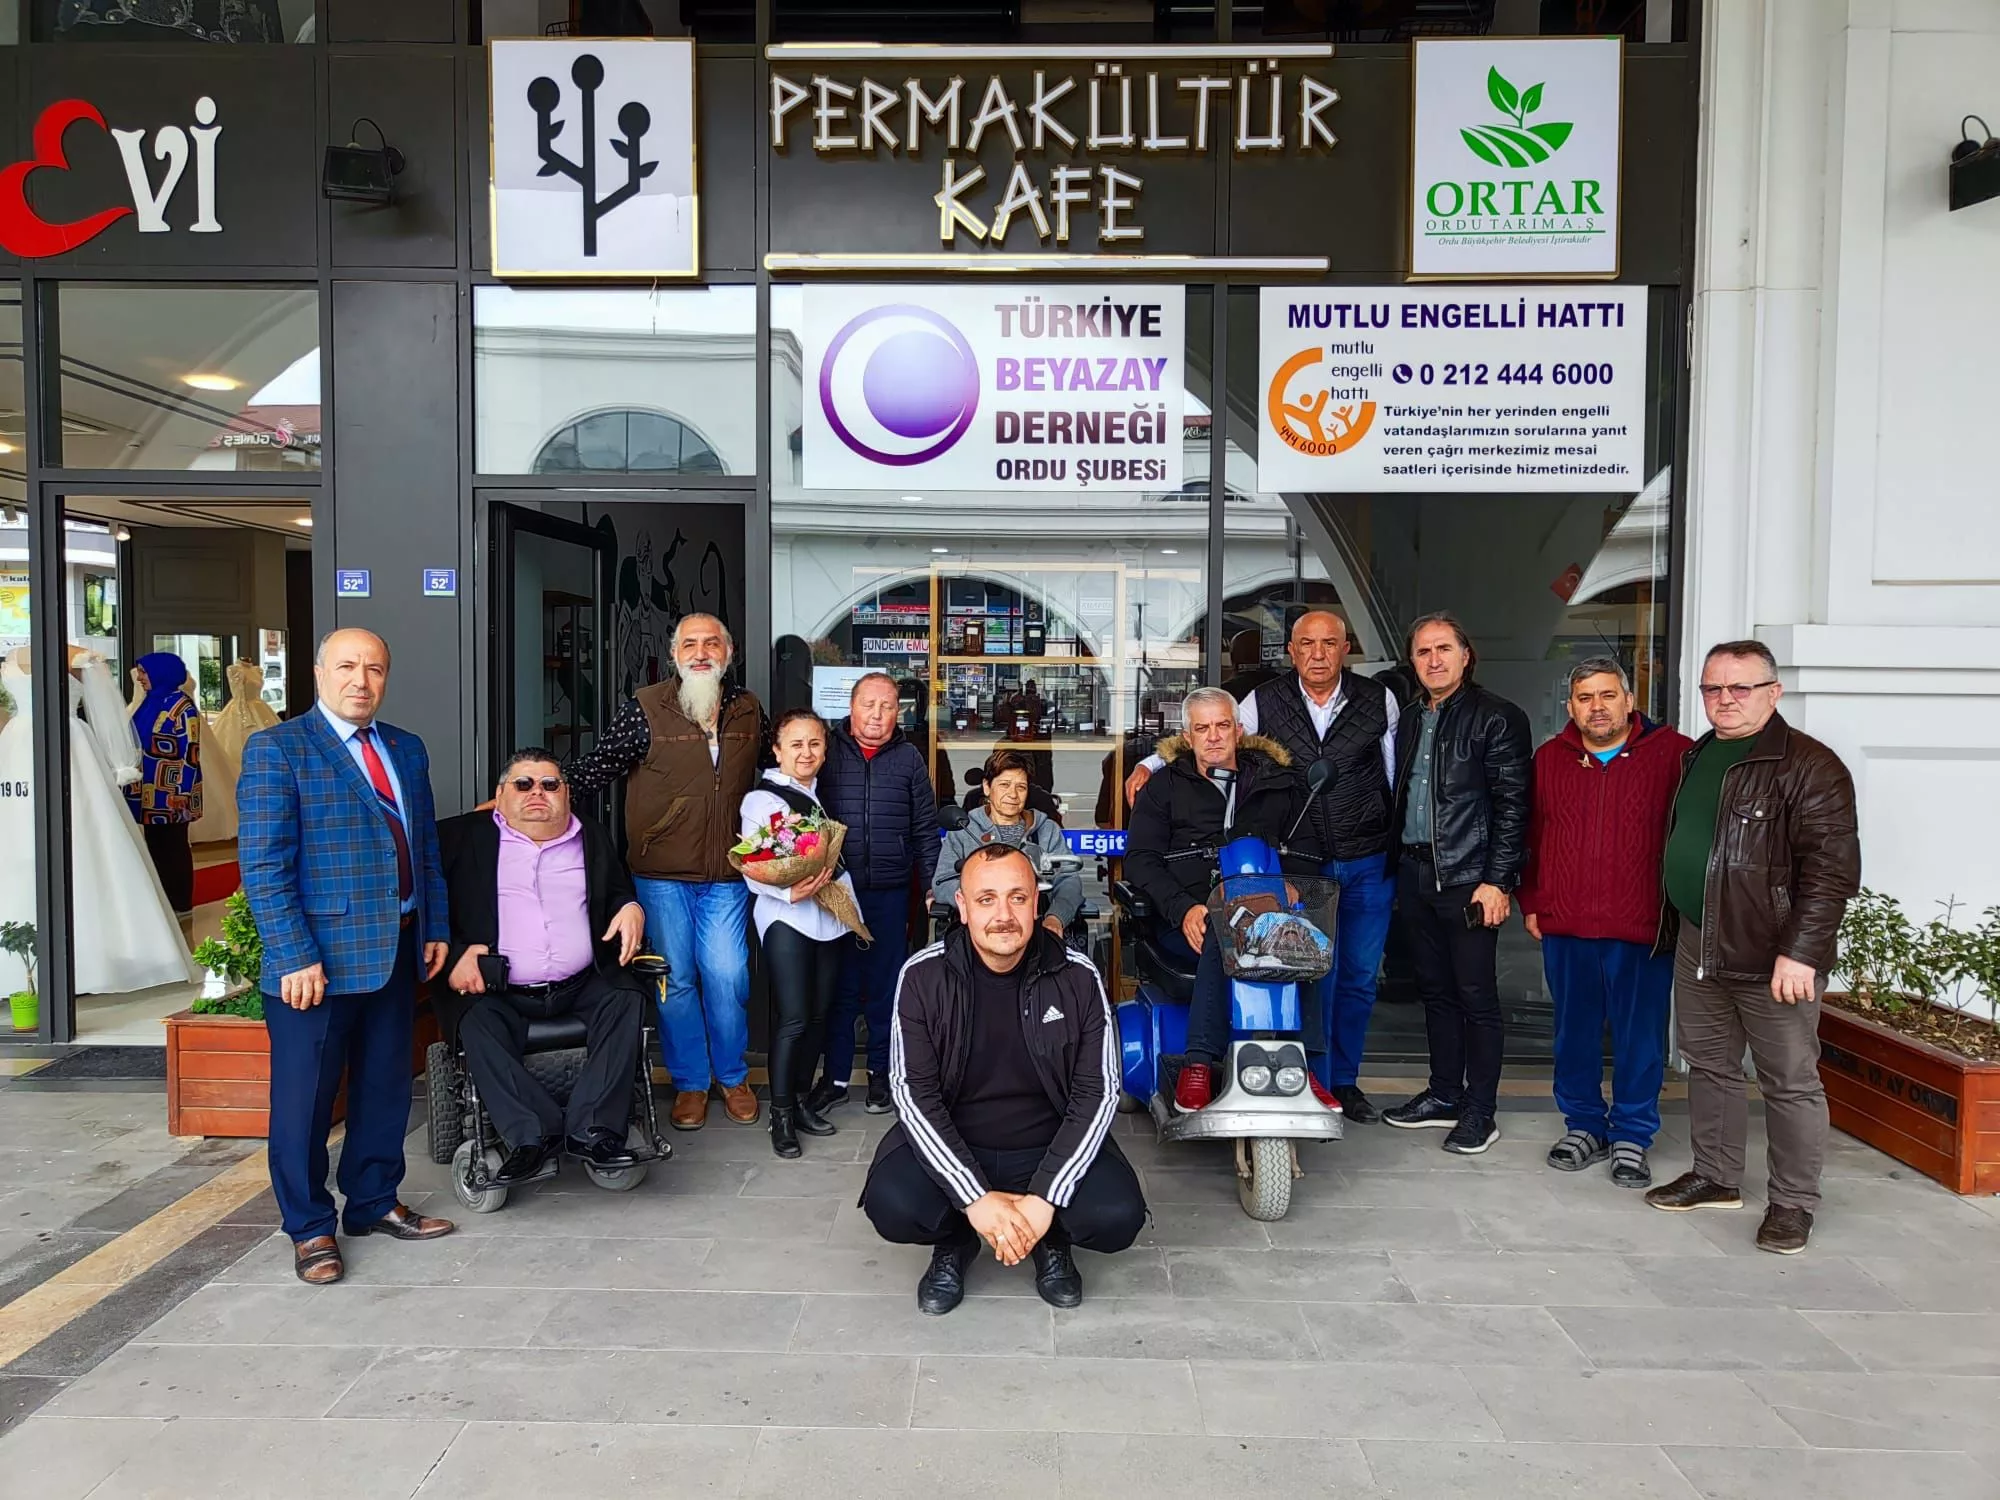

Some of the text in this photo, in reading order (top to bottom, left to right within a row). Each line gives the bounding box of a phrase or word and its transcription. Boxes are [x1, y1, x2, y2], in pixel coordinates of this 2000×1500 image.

[769, 60, 1341, 152] PERMAKÜLTÜR
[934, 159, 1144, 241] KAFE
[1426, 180, 1604, 217] ORTAR
[1426, 219, 1482, 231] ORDU
[1438, 237, 1459, 246] Ordu
[994, 296, 1162, 338] TÜRKİYE
[1288, 298, 1624, 328] MUTLU ENGELLİ HATTI
[1331, 341, 1374, 354] mutlu
[996, 357, 1168, 391] BEYAZAY
[1331, 364, 1382, 381] engelli
[1420, 363, 1613, 385] 0 212 444 6000
[1331, 386, 1369, 400] hattı
[1468, 406, 1491, 417] her
[1495, 406, 1557, 419] yerinden
[1562, 405, 1610, 419] engelli
[995, 403, 1167, 444] DERNEĞİ
[1384, 425, 1628, 438] vatandaşlarımızın sorularına yanıt
[1280, 425, 1337, 455] 444 6000
[1384, 444, 1597, 458] veren çağrı merkezimiz mesai
[996, 459, 1066, 480] ORDU
[1383, 463, 1629, 477] saatleri içerisinde hizmetinizdedir.
[1080, 834, 1128, 854] Eğit
